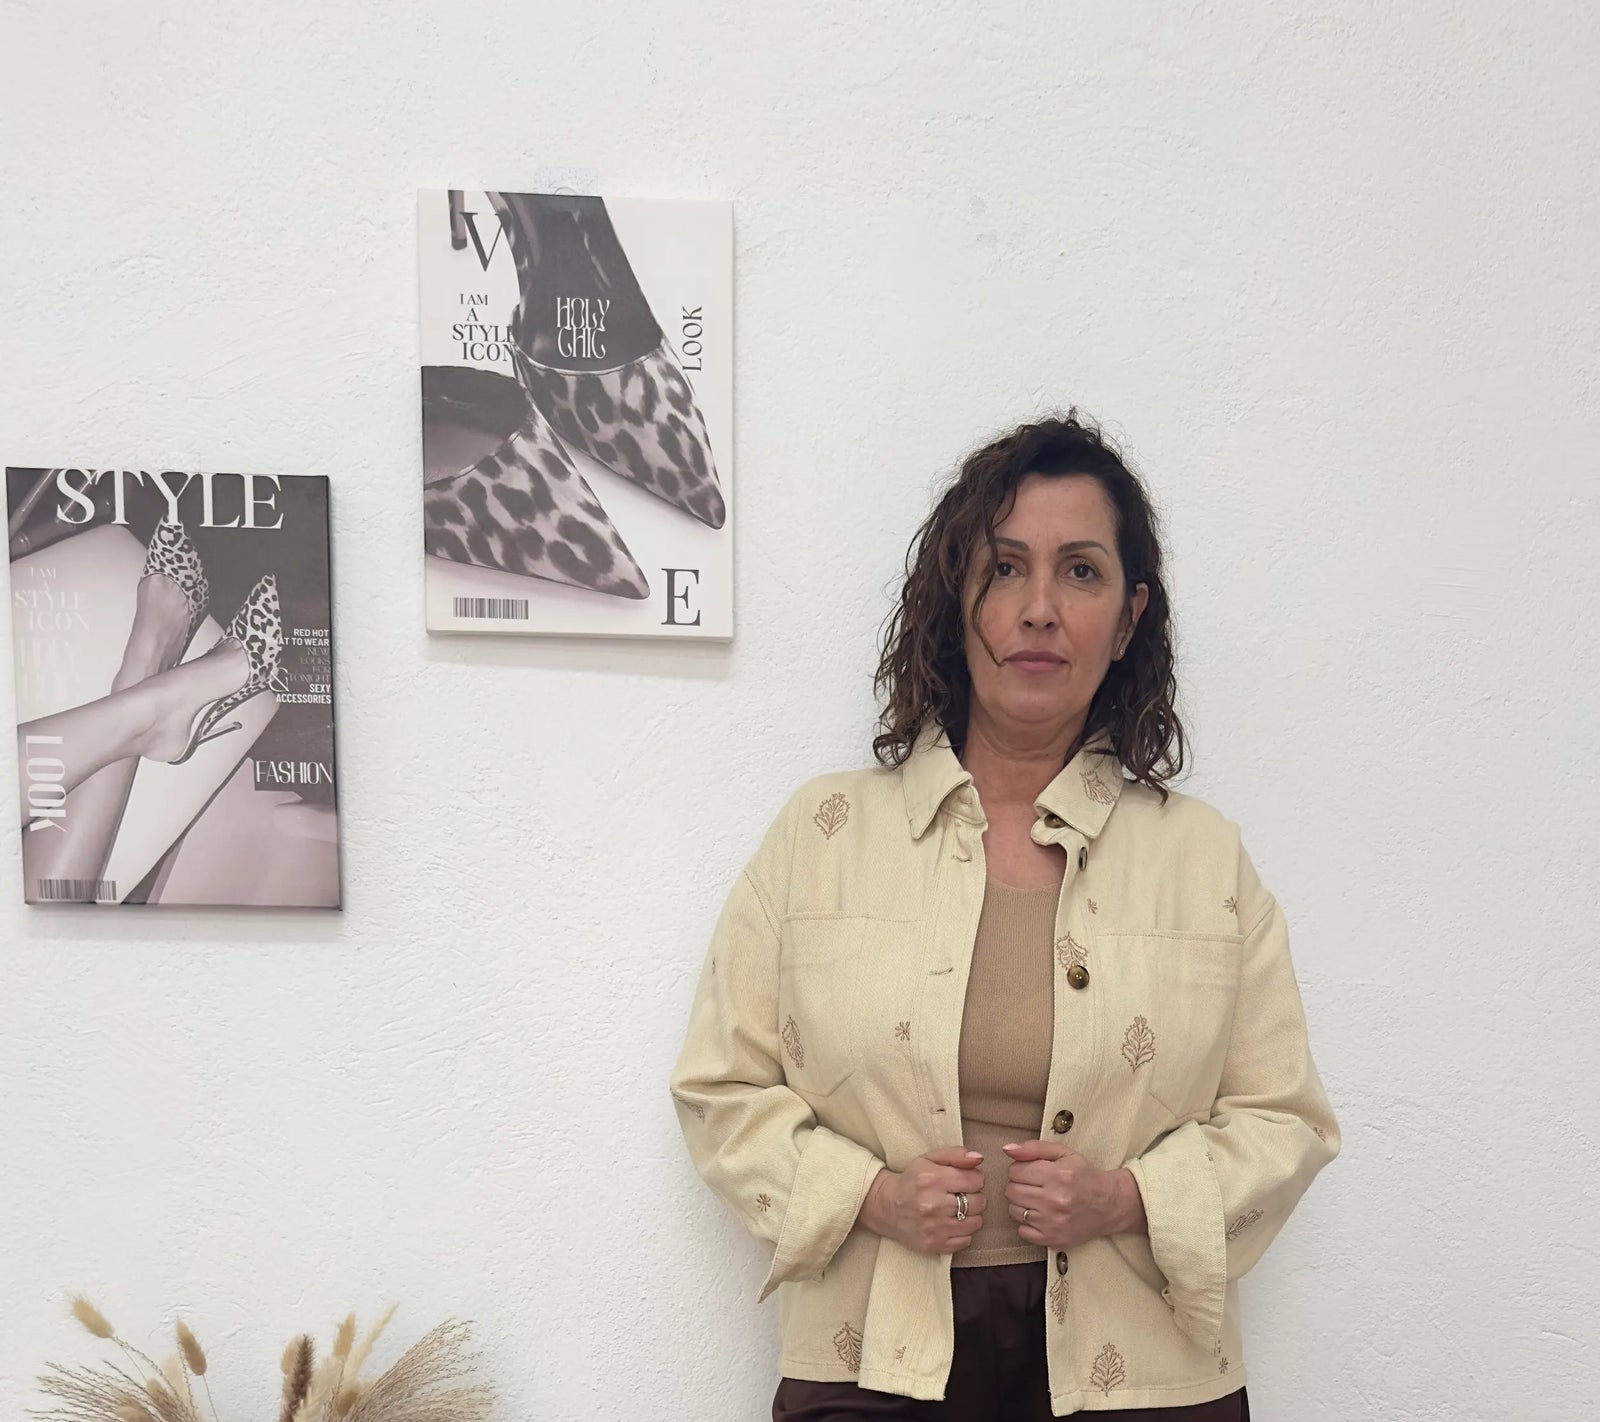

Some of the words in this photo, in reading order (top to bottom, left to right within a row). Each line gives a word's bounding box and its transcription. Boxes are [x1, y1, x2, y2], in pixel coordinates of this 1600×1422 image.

[460, 293, 464, 305] I
[467, 294, 488, 306] AM
[466, 307, 479, 322] A
[556, 297, 610, 331] HOLY
[557, 326, 606, 359] CHIC
[682, 306, 703, 371] LOOK
[462, 342, 514, 361] ICON
[56, 468, 284, 530] STYLE
[661, 568, 701, 626] E
[291, 637, 303, 646] TO
[304, 638, 330, 647] WEAR
[294, 628, 311, 637] RED
[312, 629, 329, 637] HOT
[307, 647, 329, 656] NEW
[309, 683, 331, 694] SEXY
[276, 693, 332, 704] ACCESSORIES
[256, 760, 333, 785] FASHION
[26, 736, 67, 833] LOOK
